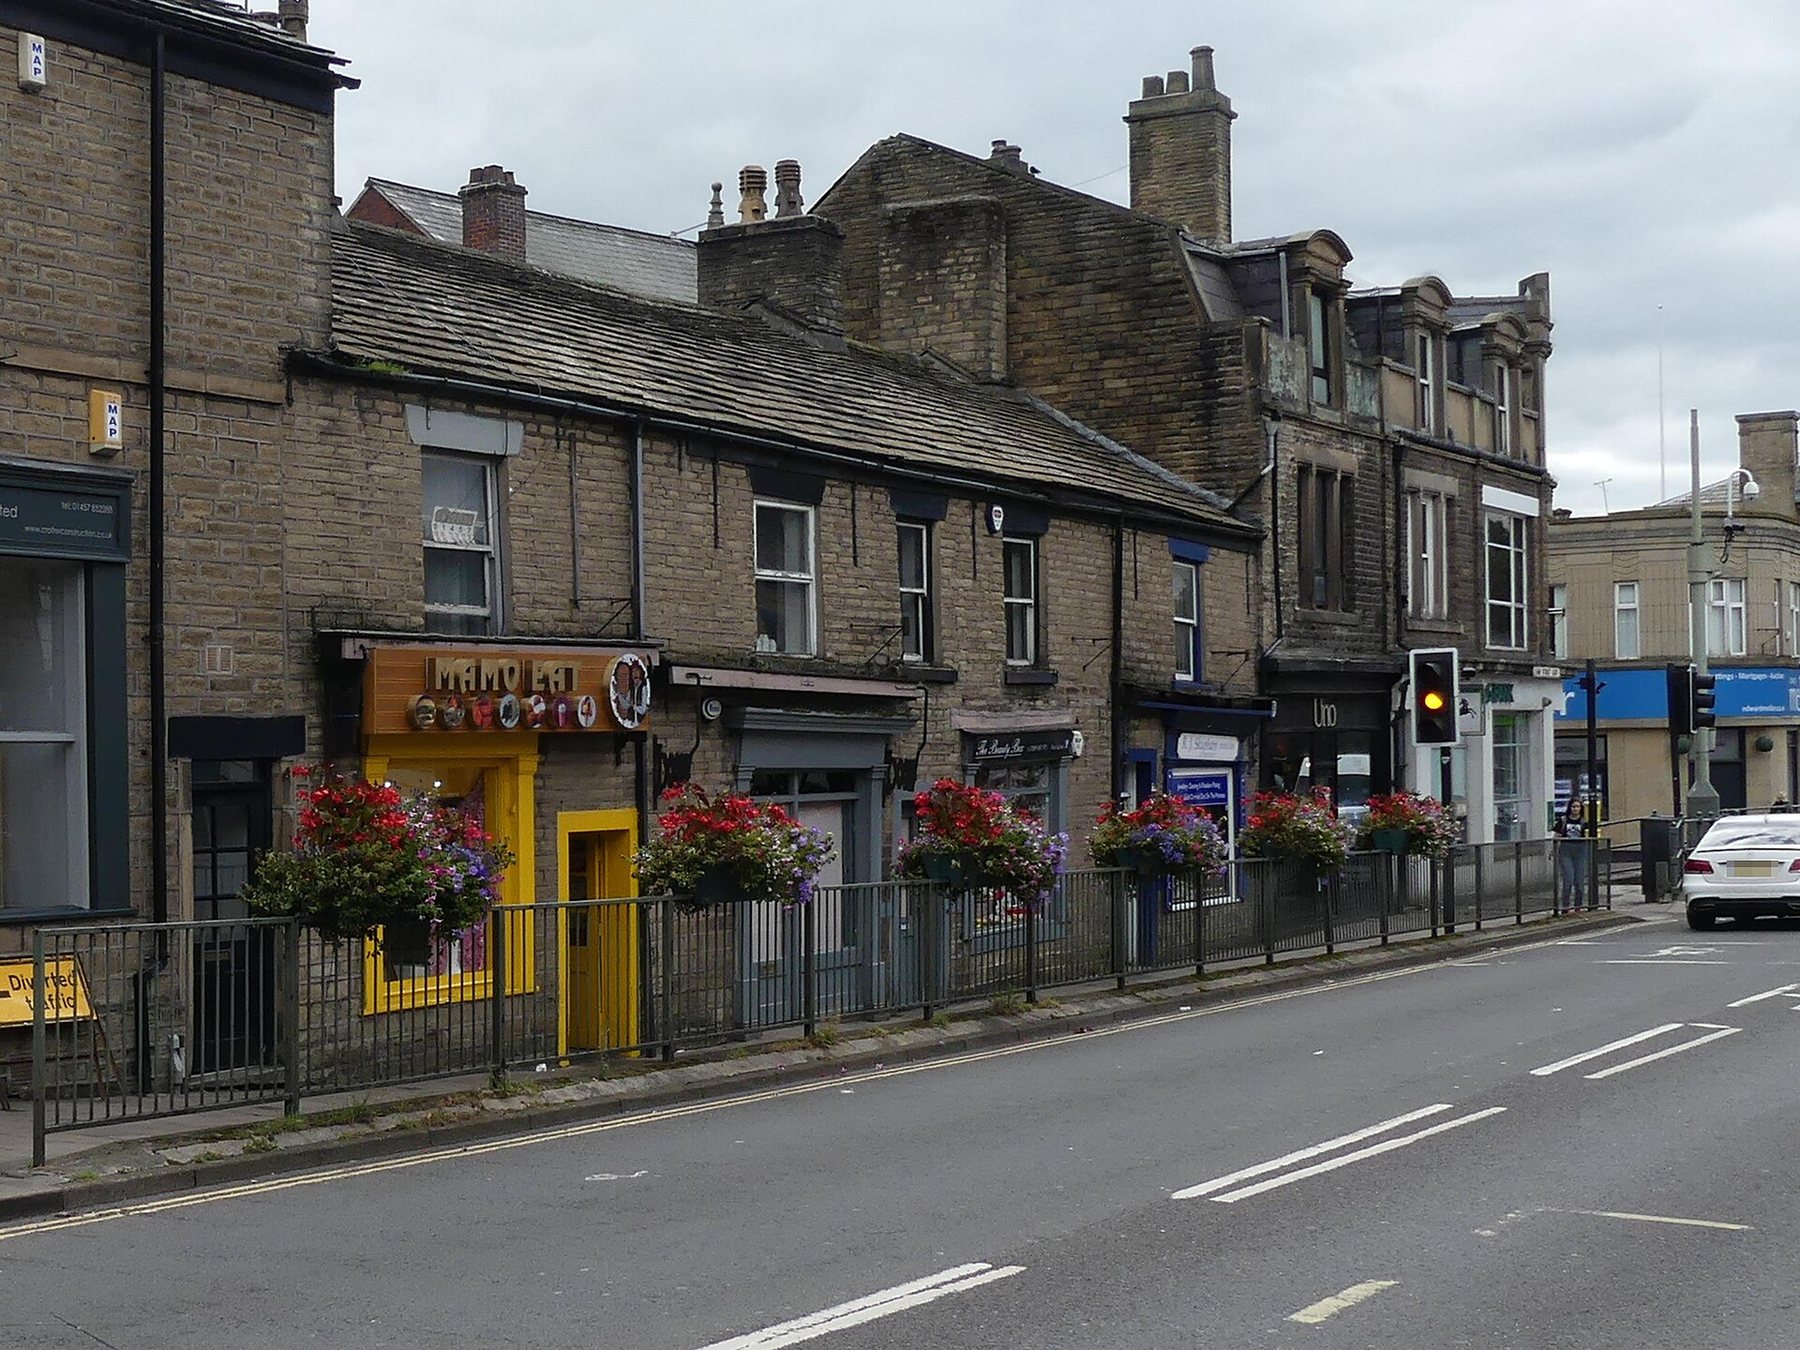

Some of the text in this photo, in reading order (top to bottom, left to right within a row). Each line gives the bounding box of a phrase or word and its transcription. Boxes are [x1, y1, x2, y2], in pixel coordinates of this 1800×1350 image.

[32, 42, 42, 76] MAP
[108, 404, 118, 437] MAP
[9, 970, 77, 991] Divrted
